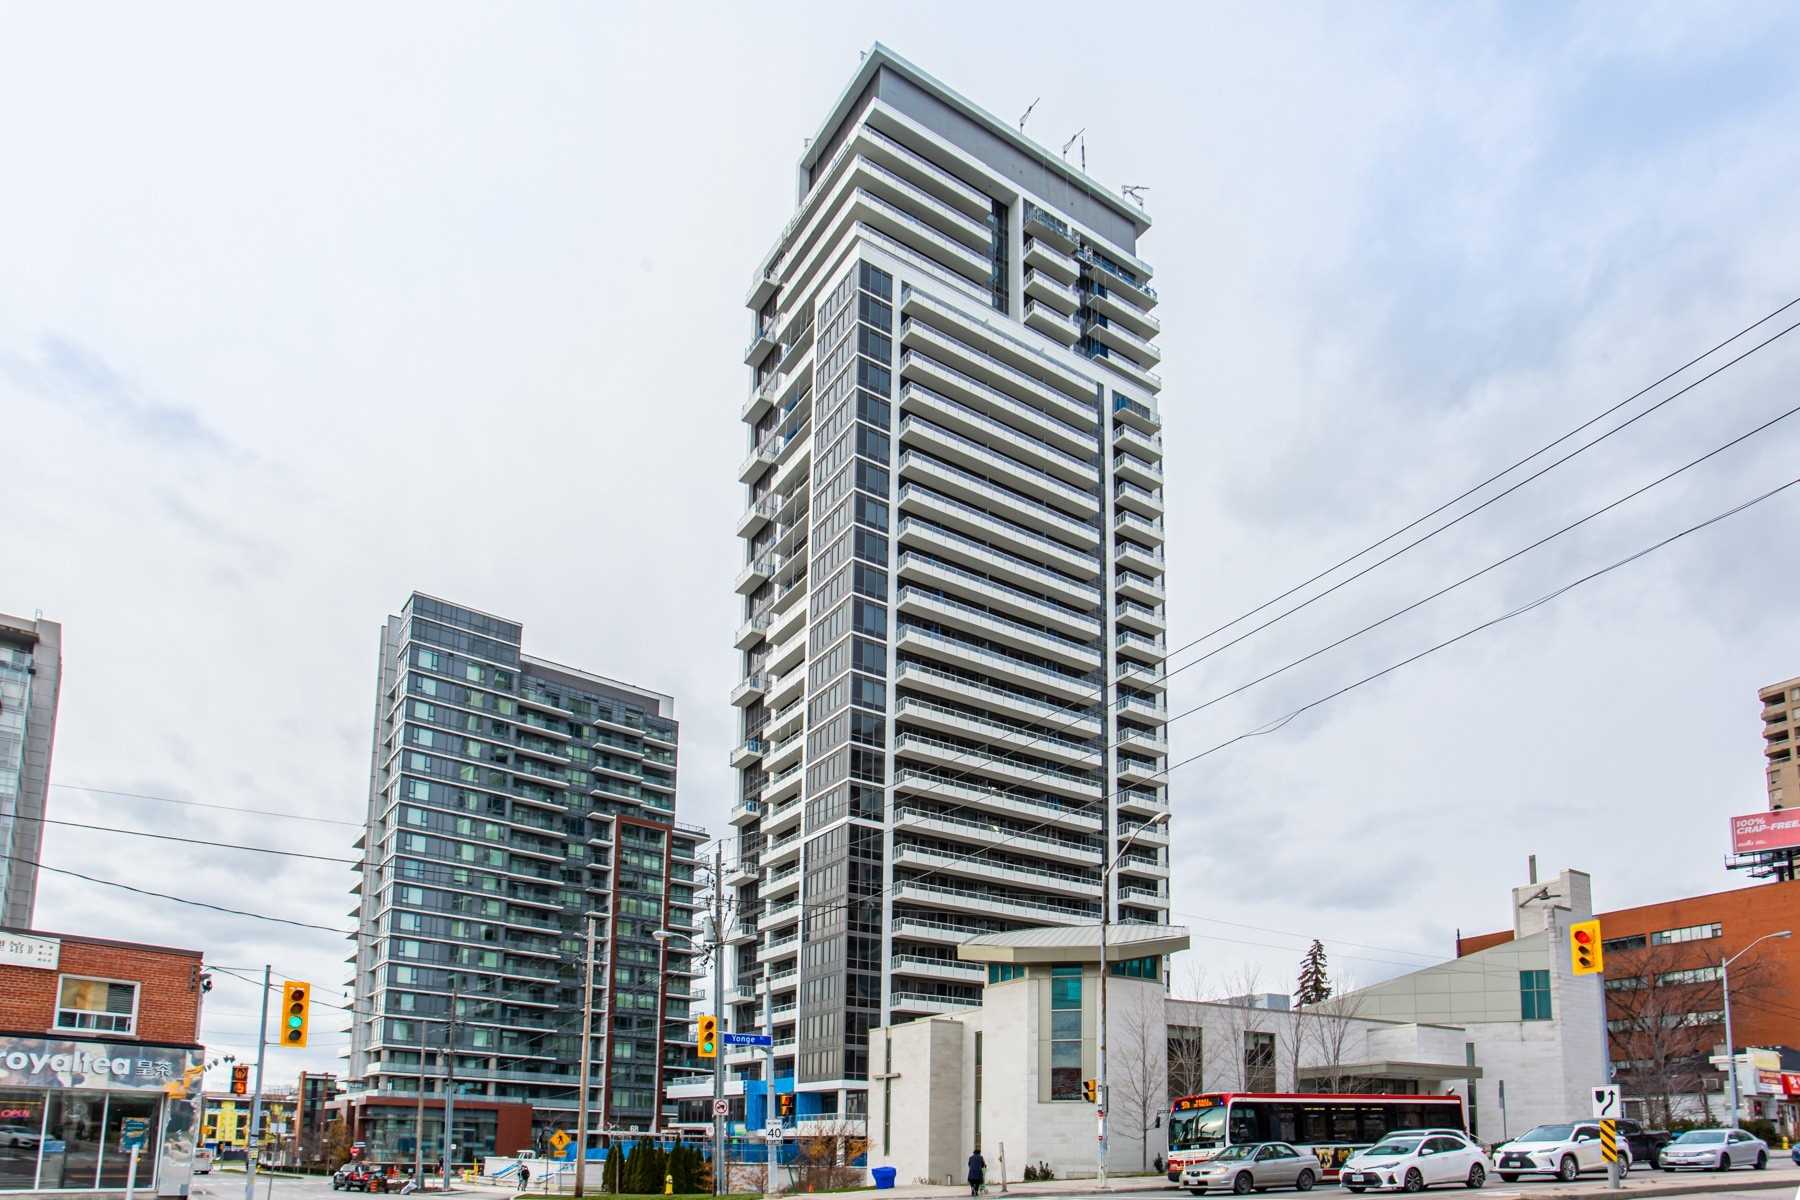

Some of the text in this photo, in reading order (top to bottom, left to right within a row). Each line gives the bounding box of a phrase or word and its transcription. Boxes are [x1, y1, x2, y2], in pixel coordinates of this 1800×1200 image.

[1736, 818, 1766, 828] 100%
[732, 1034, 756, 1044] Yonge
[136, 1058, 172, 1079] 皇茶
[767, 1128, 782, 1139] 40
